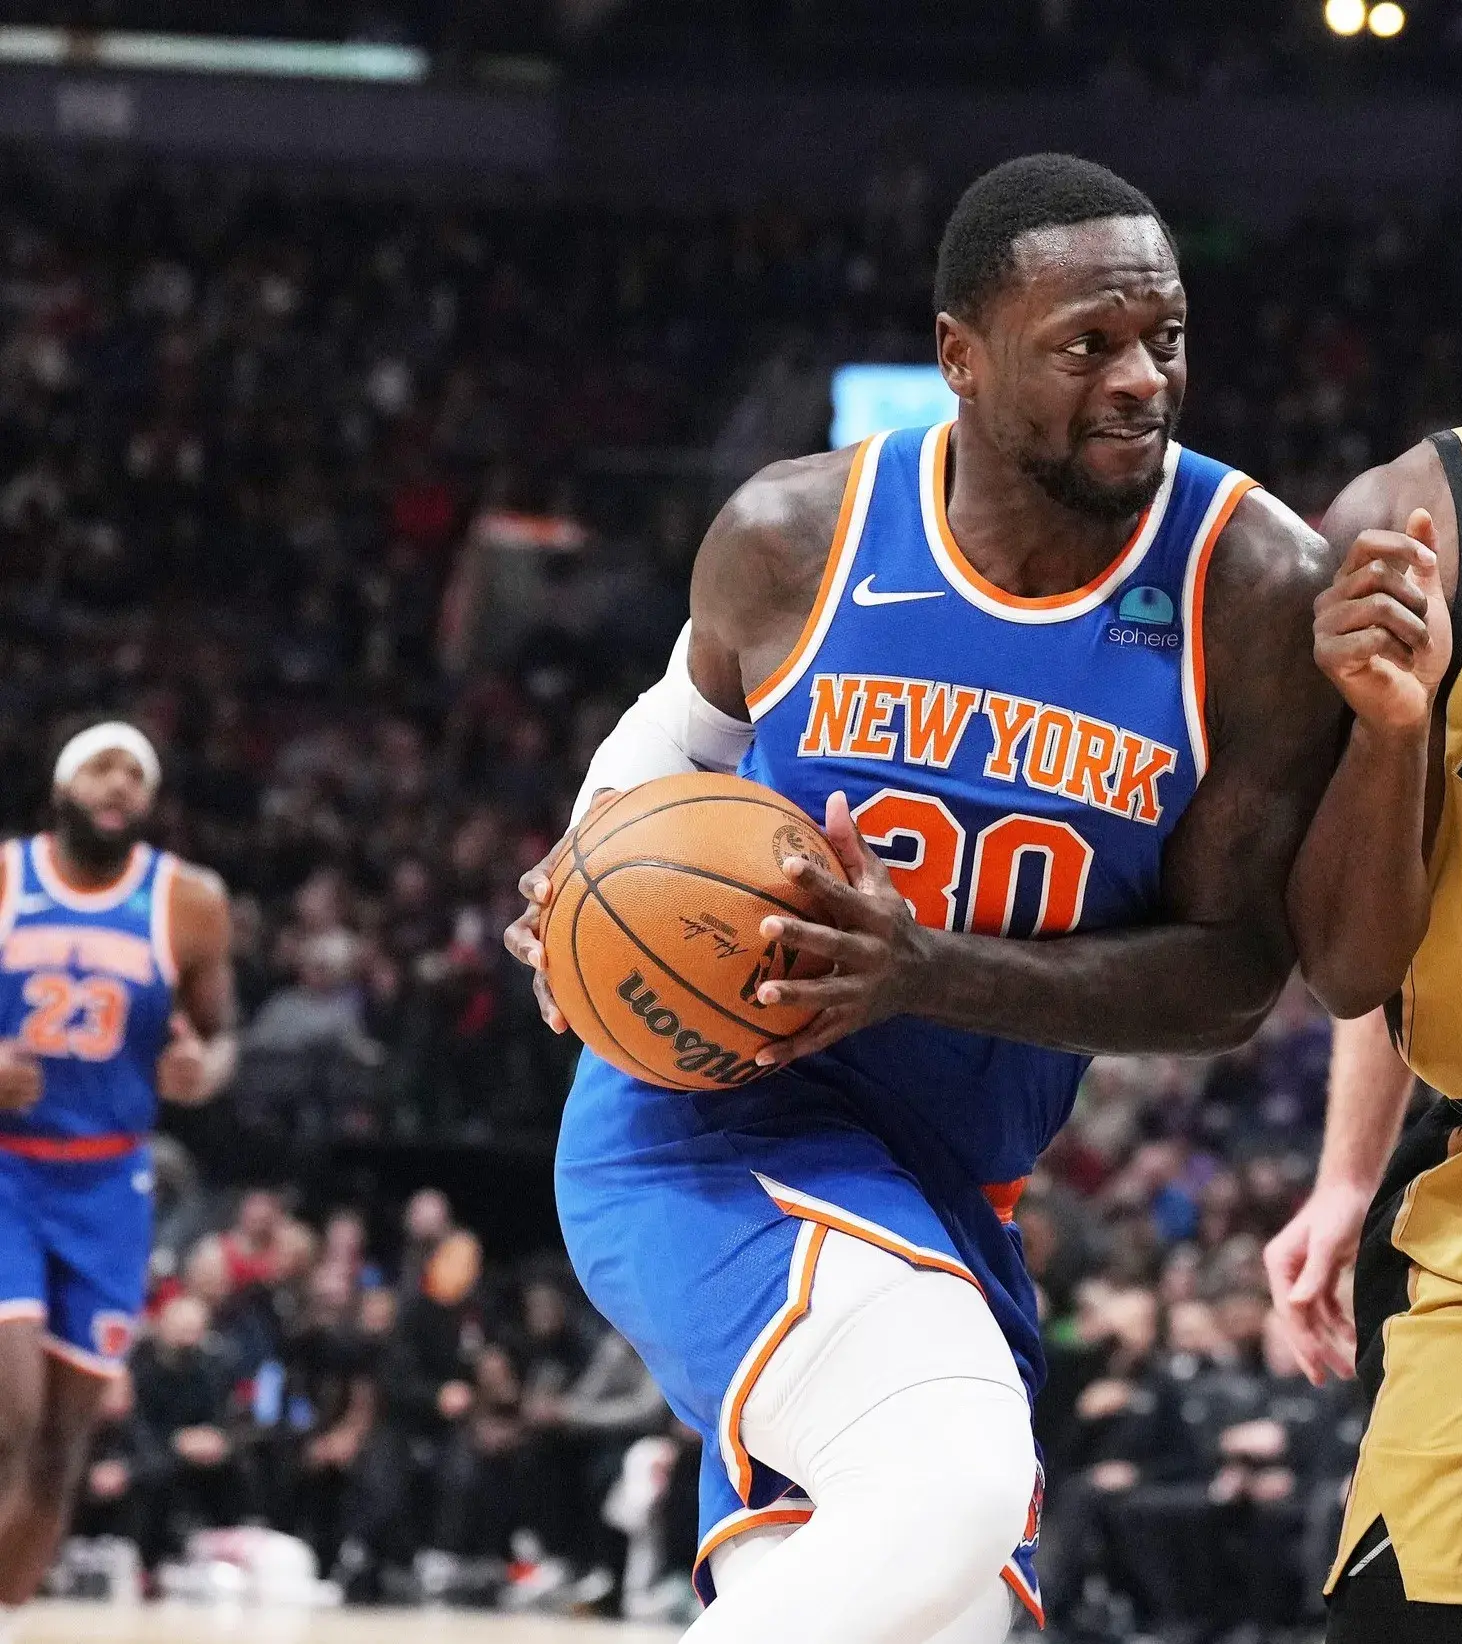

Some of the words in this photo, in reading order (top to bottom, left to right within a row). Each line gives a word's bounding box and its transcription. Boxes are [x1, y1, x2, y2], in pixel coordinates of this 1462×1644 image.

[1108, 628, 1179, 647] sphere
[797, 673, 983, 769] NEW
[981, 689, 1179, 827] YORK
[850, 787, 1095, 942] 30
[22, 972, 131, 1062] 23
